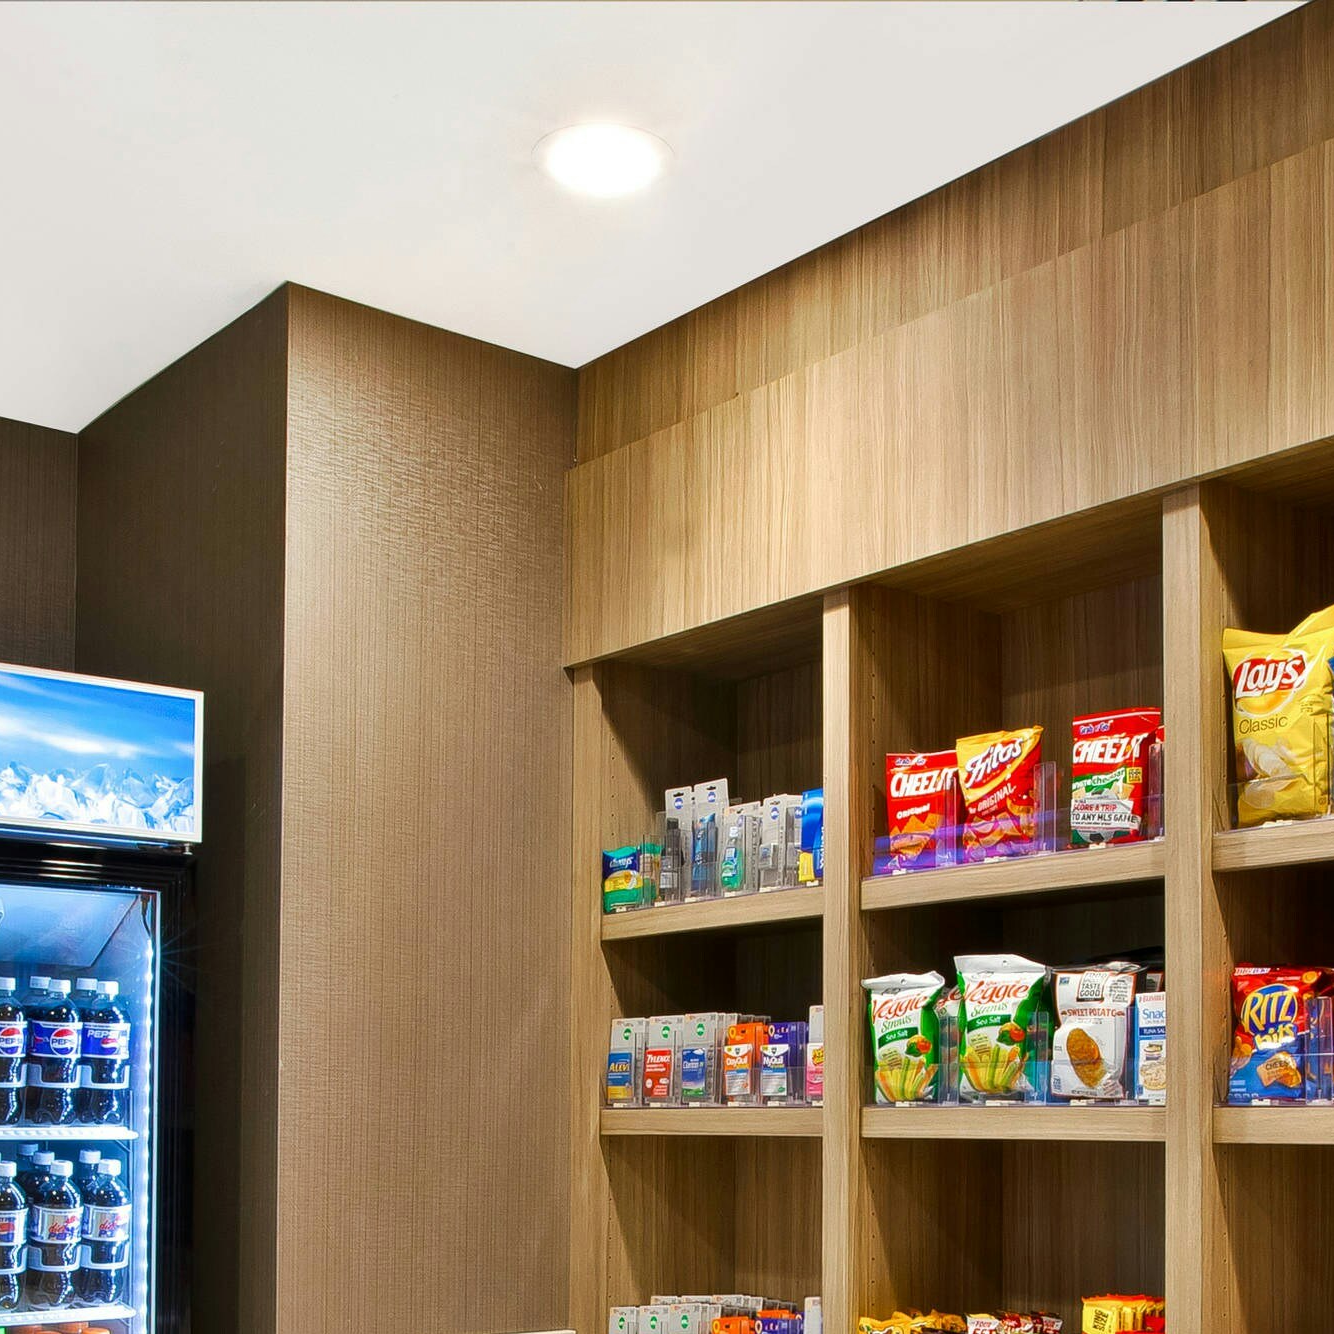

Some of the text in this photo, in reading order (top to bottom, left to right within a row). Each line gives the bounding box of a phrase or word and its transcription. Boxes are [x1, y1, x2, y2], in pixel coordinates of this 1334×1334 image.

[1235, 655, 1307, 699] Lay's
[1239, 714, 1289, 735] Classic
[966, 737, 1024, 788] Fritos
[977, 784, 1017, 811] ORIGINAL
[1101, 804, 1118, 812] TRIP
[1080, 813, 1113, 823] ANY MLS
[964, 982, 1030, 1006] Veggie
[1080, 983, 1101, 991] TASTE
[1080, 990, 1101, 998] GOOD
[872, 994, 928, 1024] Veggie
[970, 1001, 1008, 1017] Straws
[1067, 1008, 1088, 1017] SWEET
[1244, 990, 1294, 1032] RITZ
[880, 1015, 913, 1032] Straws
[975, 1015, 1002, 1026] Sea Salt
[884, 1029, 909, 1040] Sea Salt
[1092, 1308, 1103, 1331] KING
[1099, 1311, 1110, 1331] SIZE
